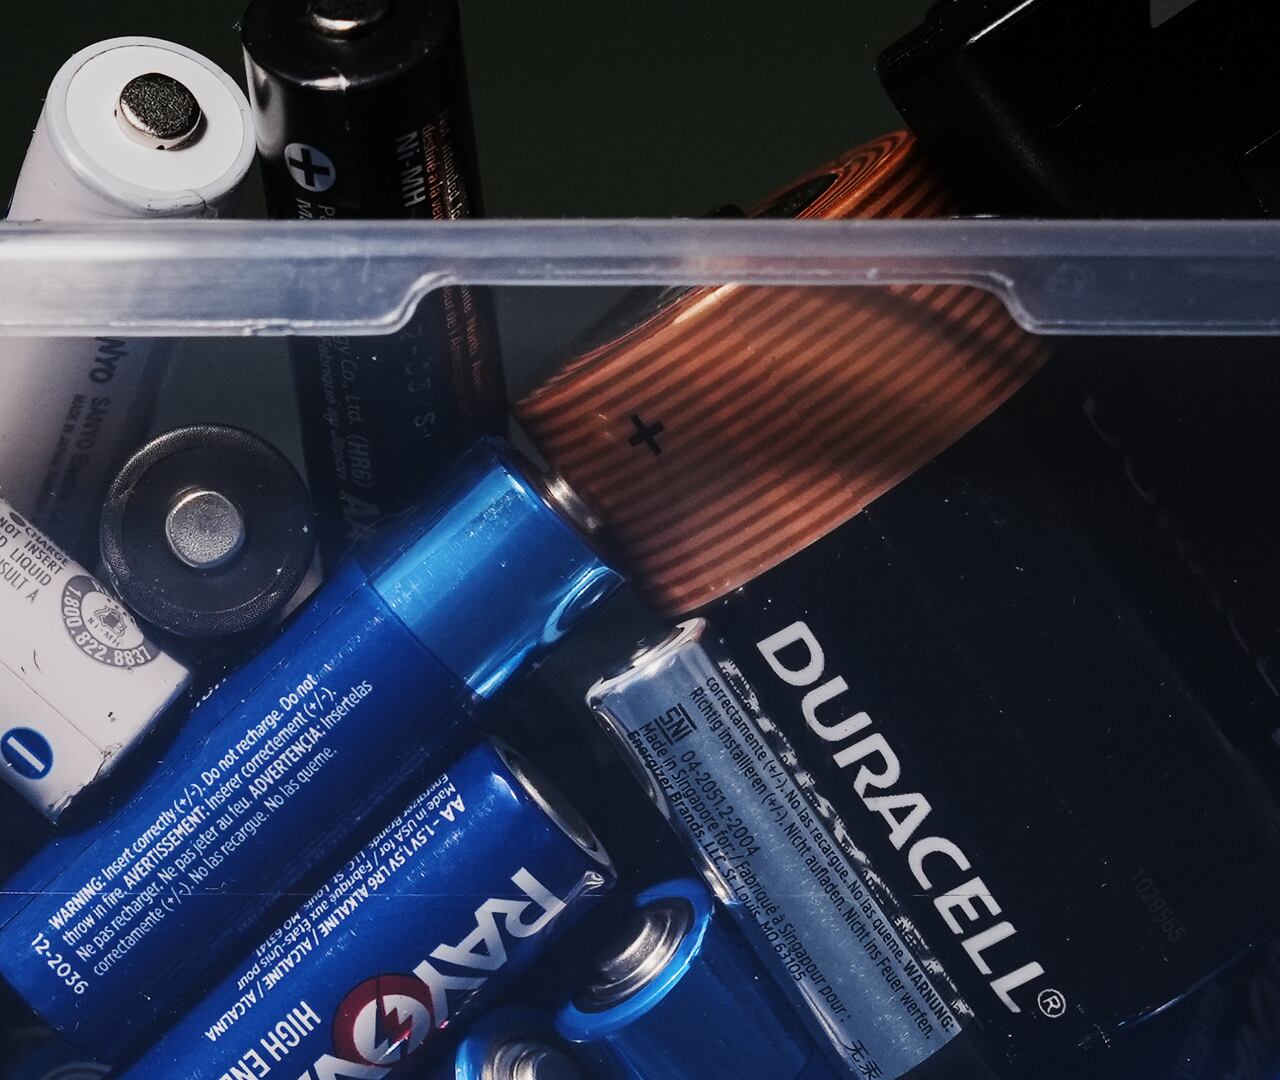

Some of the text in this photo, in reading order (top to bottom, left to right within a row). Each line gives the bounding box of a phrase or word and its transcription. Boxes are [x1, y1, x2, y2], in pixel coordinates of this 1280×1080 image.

[390, 131, 429, 207] Ni-MH
[7, 545, 55, 588] LIQUID
[22, 538, 65, 576] INSERT
[25, 586, 42, 603] A
[46, 872, 108, 931] WARNING:
[100, 845, 136, 881] Insert
[128, 805, 180, 855] correctly
[200, 763, 223, 785] Do
[217, 748, 240, 770] not
[233, 705, 286, 757] recharge.
[278, 689, 301, 712] Do
[294, 673, 319, 697] not
[60, 910, 98, 947] throw
[90, 901, 108, 919] in
[120, 803, 212, 890] AVERTISSEMENT:
[202, 769, 246, 812] Insérer
[237, 710, 309, 779] correctement
[75, 940, 97, 962] Ne
[91, 924, 118, 950] pas
[107, 877, 166, 933] recharger.
[157, 863, 179, 884] Ne
[172, 847, 199, 873] pas
[189, 823, 222, 855] jeter
[214, 811, 234, 831] au
[226, 791, 254, 819] feu.
[318, 677, 374, 730] Insértelas
[437, 793, 468, 823] AA
[678, 748, 762, 858] 04-2051.2-2004
[754, 615, 1057, 1017] DURACELL
[89, 904, 167, 978] correctamente
[187, 862, 209, 884] No
[202, 847, 225, 871] las
[217, 805, 272, 858] recargue.
[262, 790, 285, 813] No
[277, 776, 301, 799] las
[294, 742, 339, 786] queme.
[406, 822, 436, 851] 1.5V
[684, 686, 724, 734] Richtig
[715, 727, 770, 797] installieren
[781, 822, 812, 857] Nicht
[802, 852, 851, 912] aufladen.
[841, 906, 871, 941] Nicht
[862, 937, 885, 961] ins
[875, 956, 907, 994] Feuer
[897, 988, 939, 1040] werfen.
[364, 863, 392, 891] LR6
[638, 721, 846, 1017] Made in Singapore for: Fabriqué à Singapour pour
[314, 882, 371, 937] ALKALINE
[28, 930, 90, 996] 12-2036
[259, 935, 316, 990] ALCALINE
[202, 987, 260, 1043] ALCALINA
[257, 999, 322, 1062] HIGH
